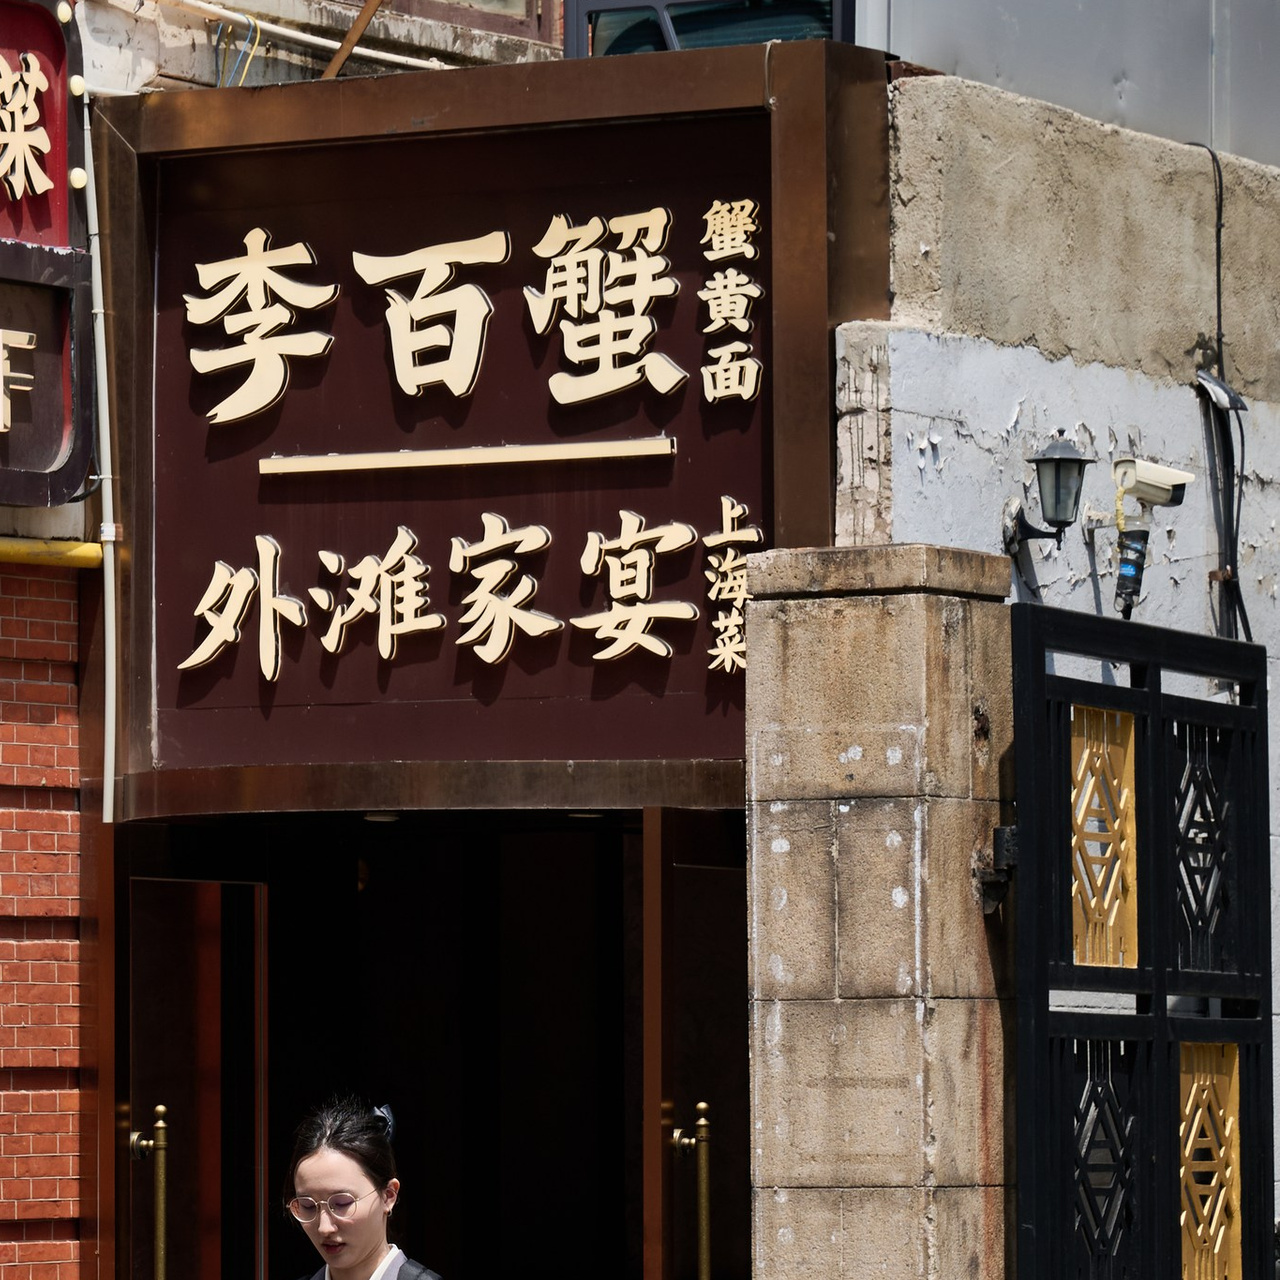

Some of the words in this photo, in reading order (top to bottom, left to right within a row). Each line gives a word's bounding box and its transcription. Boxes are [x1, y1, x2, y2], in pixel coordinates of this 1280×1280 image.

[182, 206, 690, 425] 李百蟹
[697, 198, 765, 404] 蟹黄面
[176, 508, 701, 682] 外滩家宴
[701, 494, 765, 674] 上海菜
